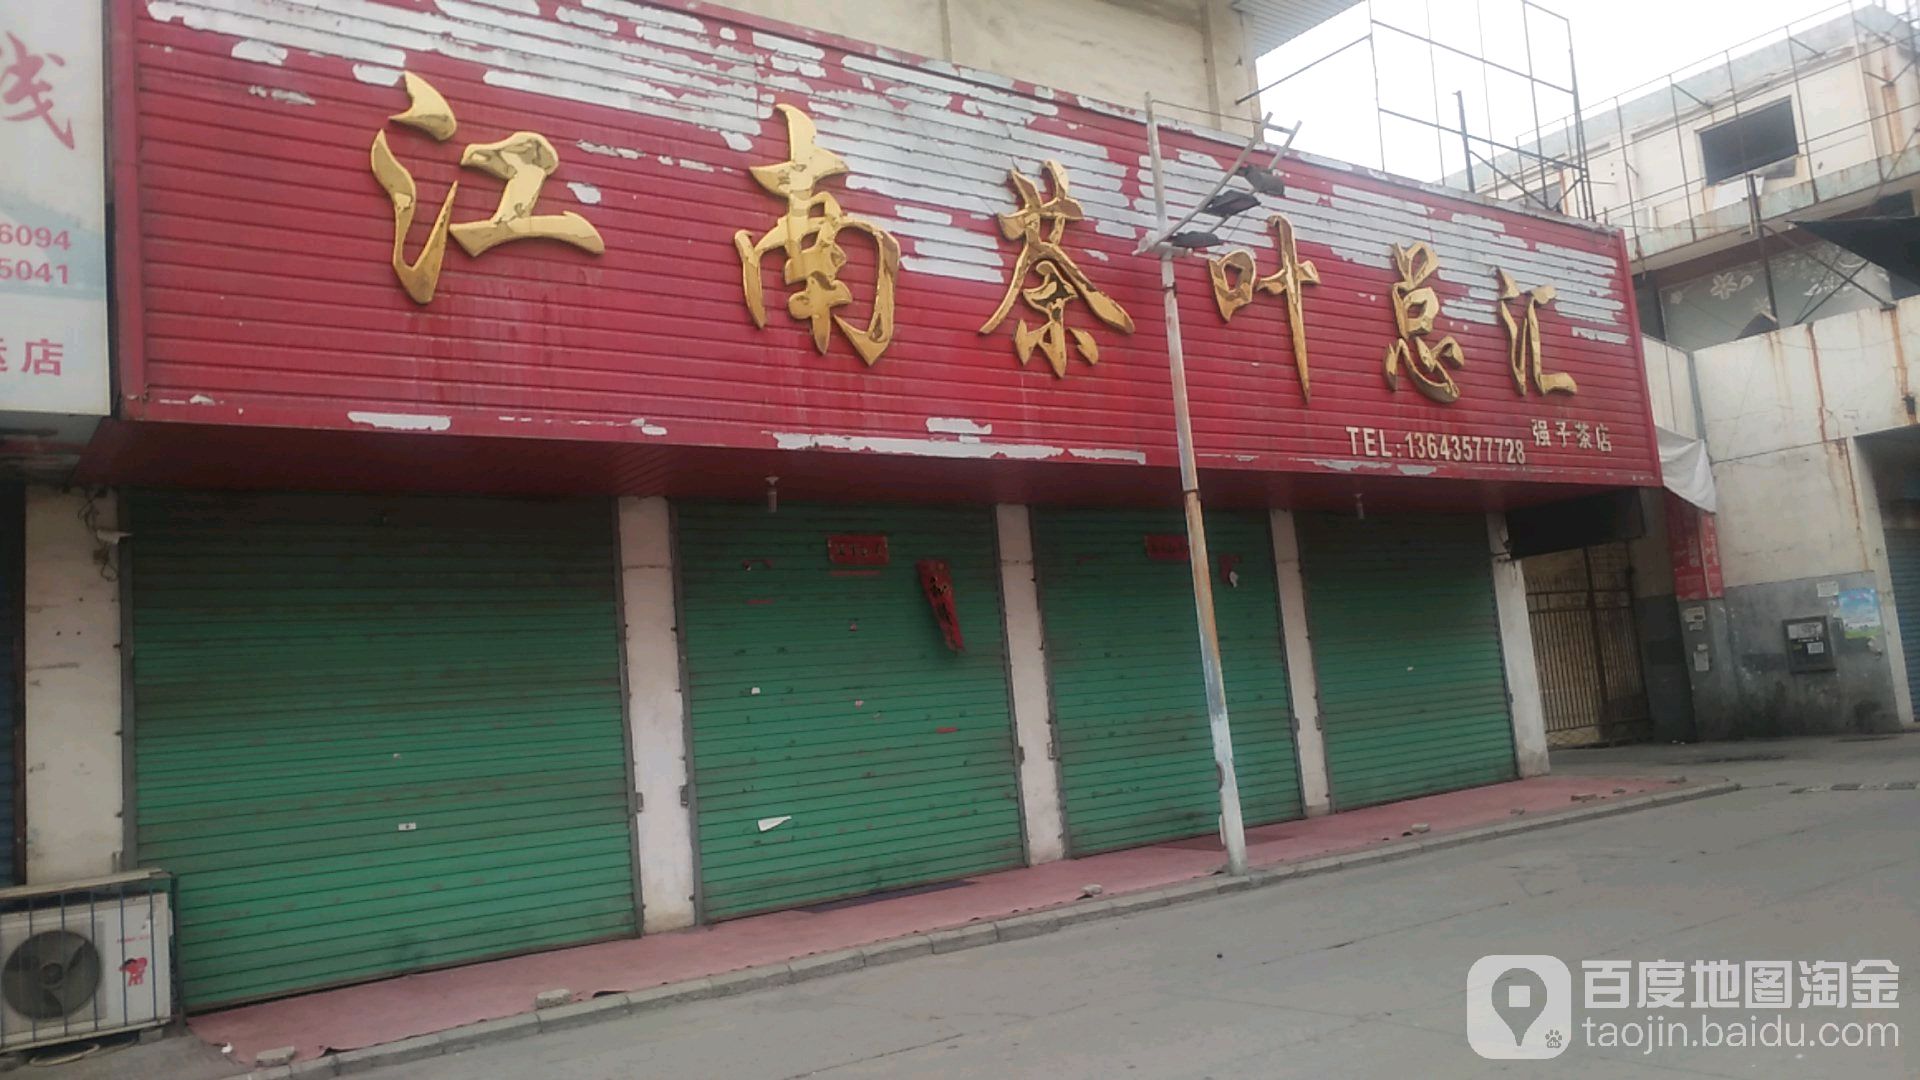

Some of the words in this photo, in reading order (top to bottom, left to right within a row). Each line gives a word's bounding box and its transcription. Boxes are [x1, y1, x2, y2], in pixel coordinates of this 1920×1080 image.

[0, 223, 72, 251] 6094
[368, 69, 1579, 404] 江南茶叶总汇
[0, 337, 64, 377] 店
[1531, 418, 1613, 453] 强子茶店
